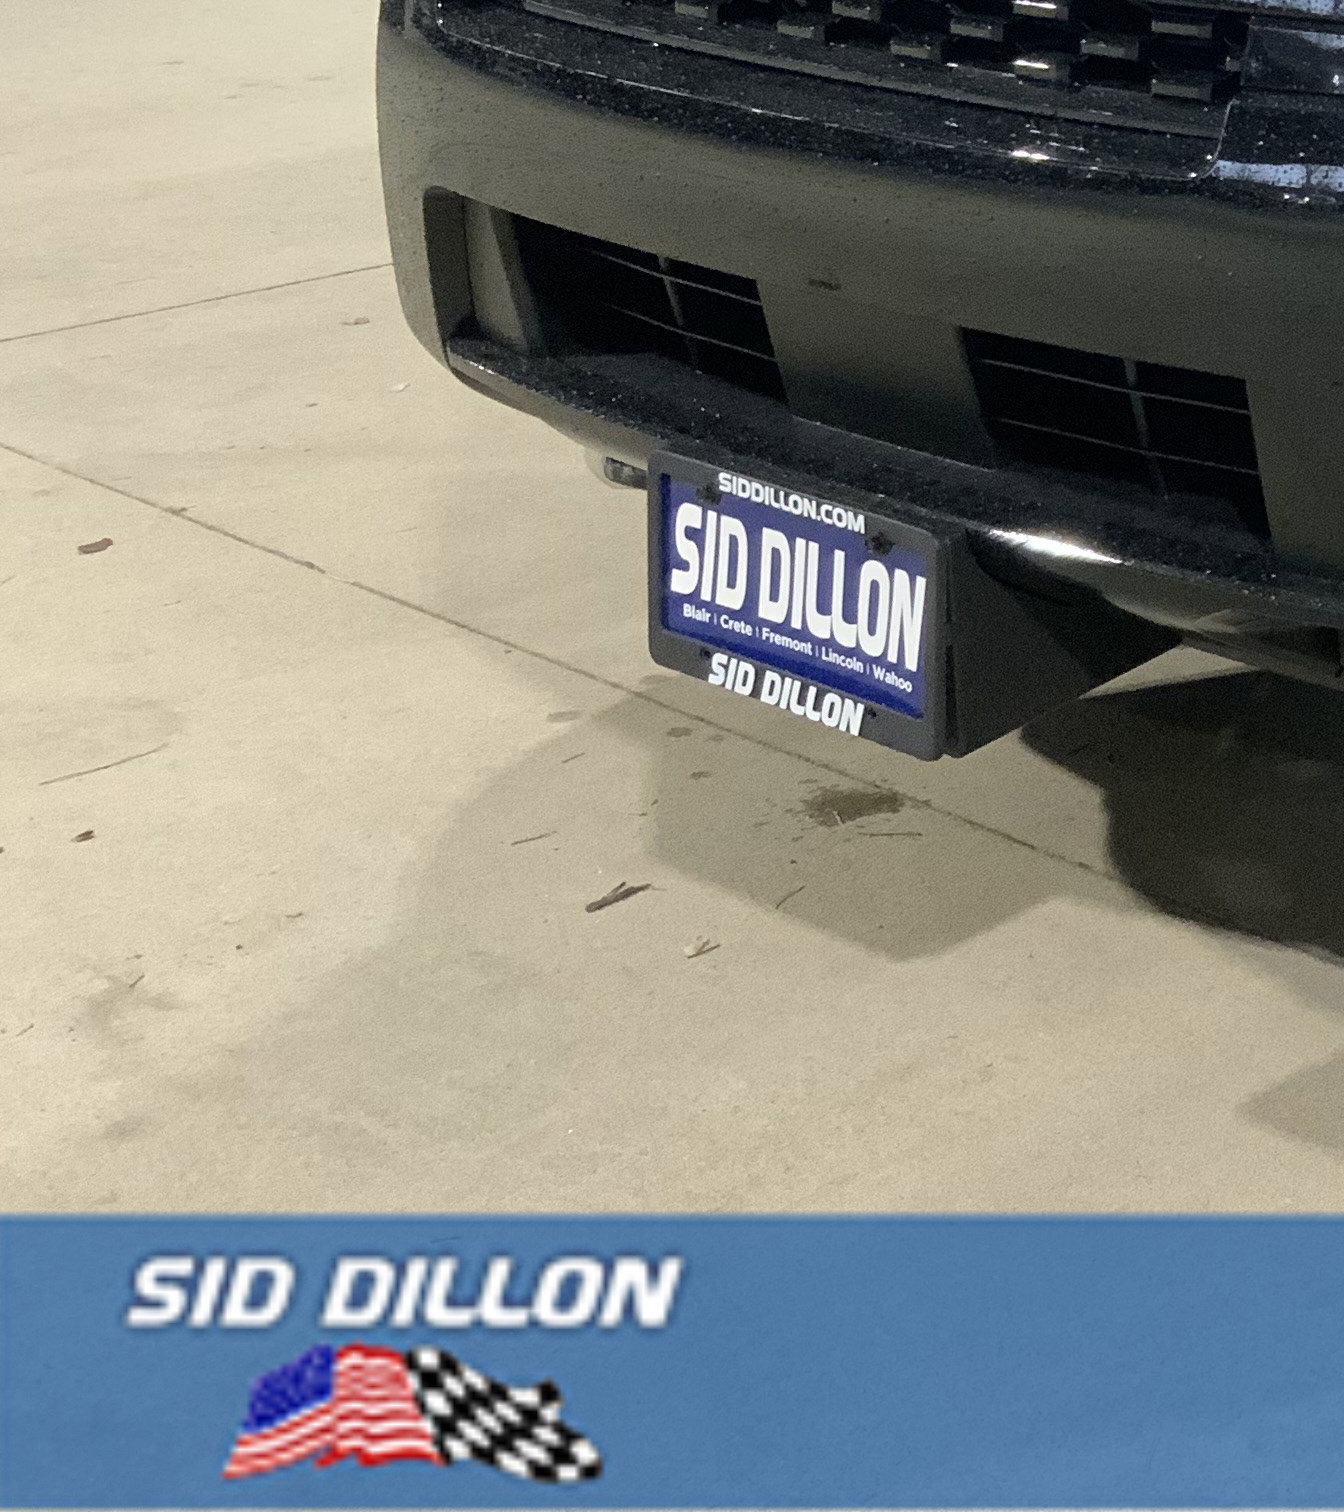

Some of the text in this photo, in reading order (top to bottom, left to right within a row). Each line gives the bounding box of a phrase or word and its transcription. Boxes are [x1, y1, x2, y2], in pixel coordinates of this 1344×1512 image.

[718, 472, 866, 534] SIDDILLON.COM
[670, 502, 927, 672] SID DILLON
[682, 602, 913, 693] Blair Crete Fremont Lincoln Wahoo
[707, 652, 865, 737] SID DILLON
